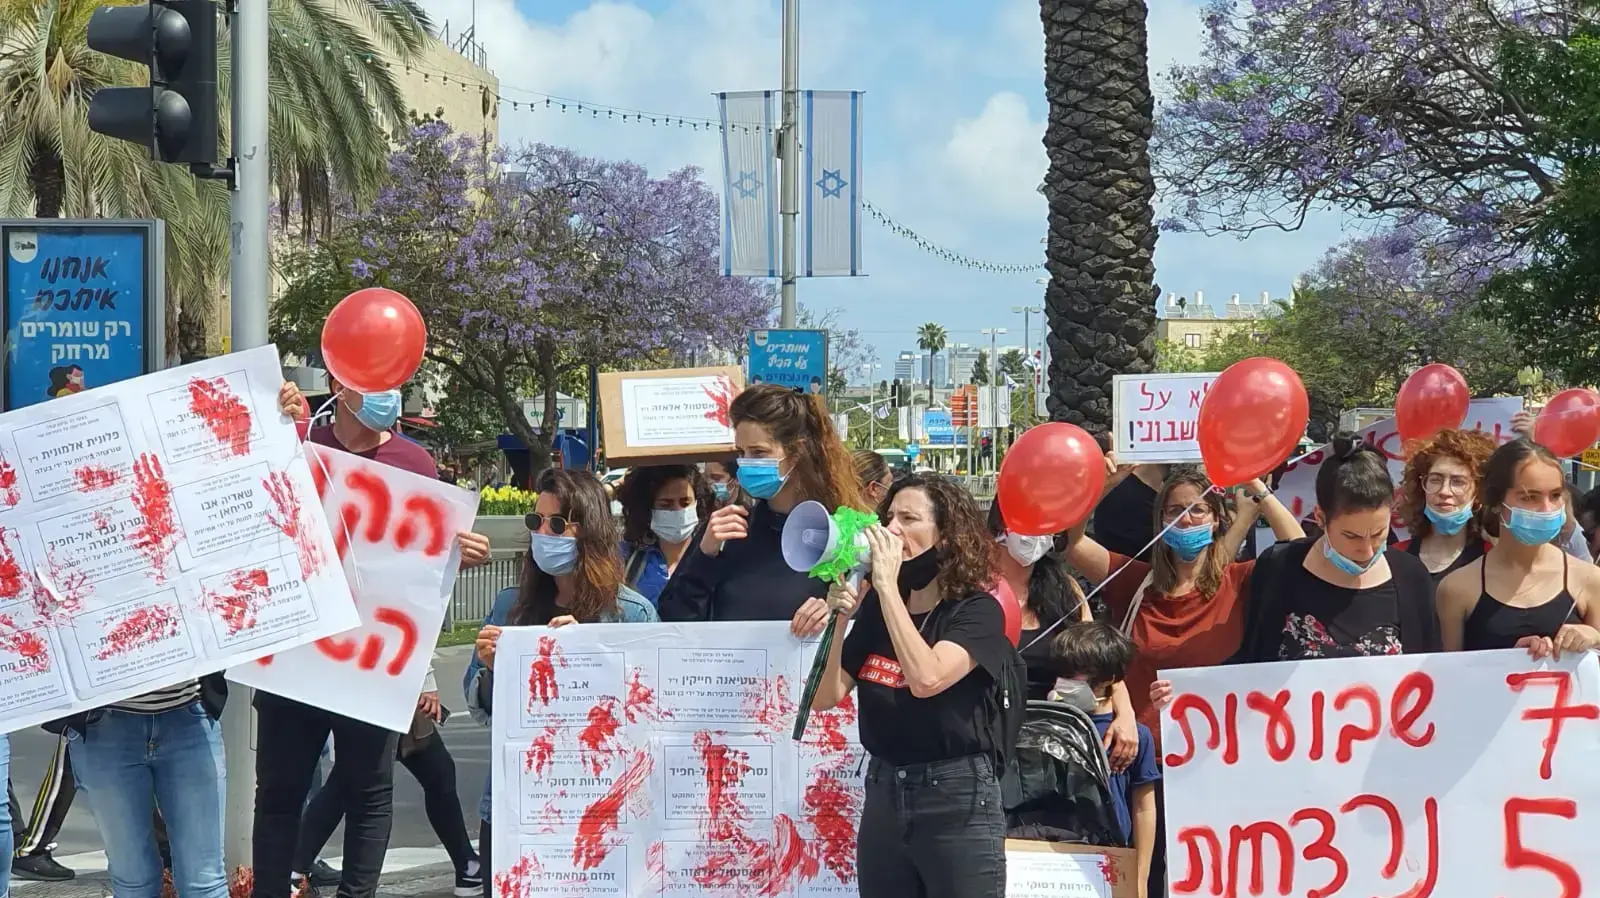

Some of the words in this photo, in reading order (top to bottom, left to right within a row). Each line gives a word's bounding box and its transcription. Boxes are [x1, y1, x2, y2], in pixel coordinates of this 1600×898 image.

[41, 256, 110, 284] אנחנו
[35, 288, 119, 311] איתכם
[22, 320, 100, 338] שומרים
[104, 320, 131, 341] רק
[52, 344, 109, 364] מרחק
[1139, 382, 1172, 411] על
[86, 429, 120, 447] פלונית
[1129, 420, 1196, 449] שבוני!
[41, 440, 84, 460] אלמונית
[201, 499, 219, 511] אבו
[220, 489, 253, 505] שאדיה
[219, 501, 254, 519] סריחאן
[96, 523, 117, 537] עבד
[120, 515, 146, 531] נסרין
[48, 529, 94, 550] אל-חפיד
[682, 676, 712, 686] חייקין
[716, 675, 757, 685] טטיאנה
[1165, 670, 1436, 767] שבועות
[1506, 670, 1600, 780] 7
[547, 778, 576, 788] דסוקי
[580, 777, 612, 787] מירוות
[1171, 794, 1439, 898] נרצחות
[1502, 796, 1583, 898] 5
[590, 872, 616, 881] זמזם
